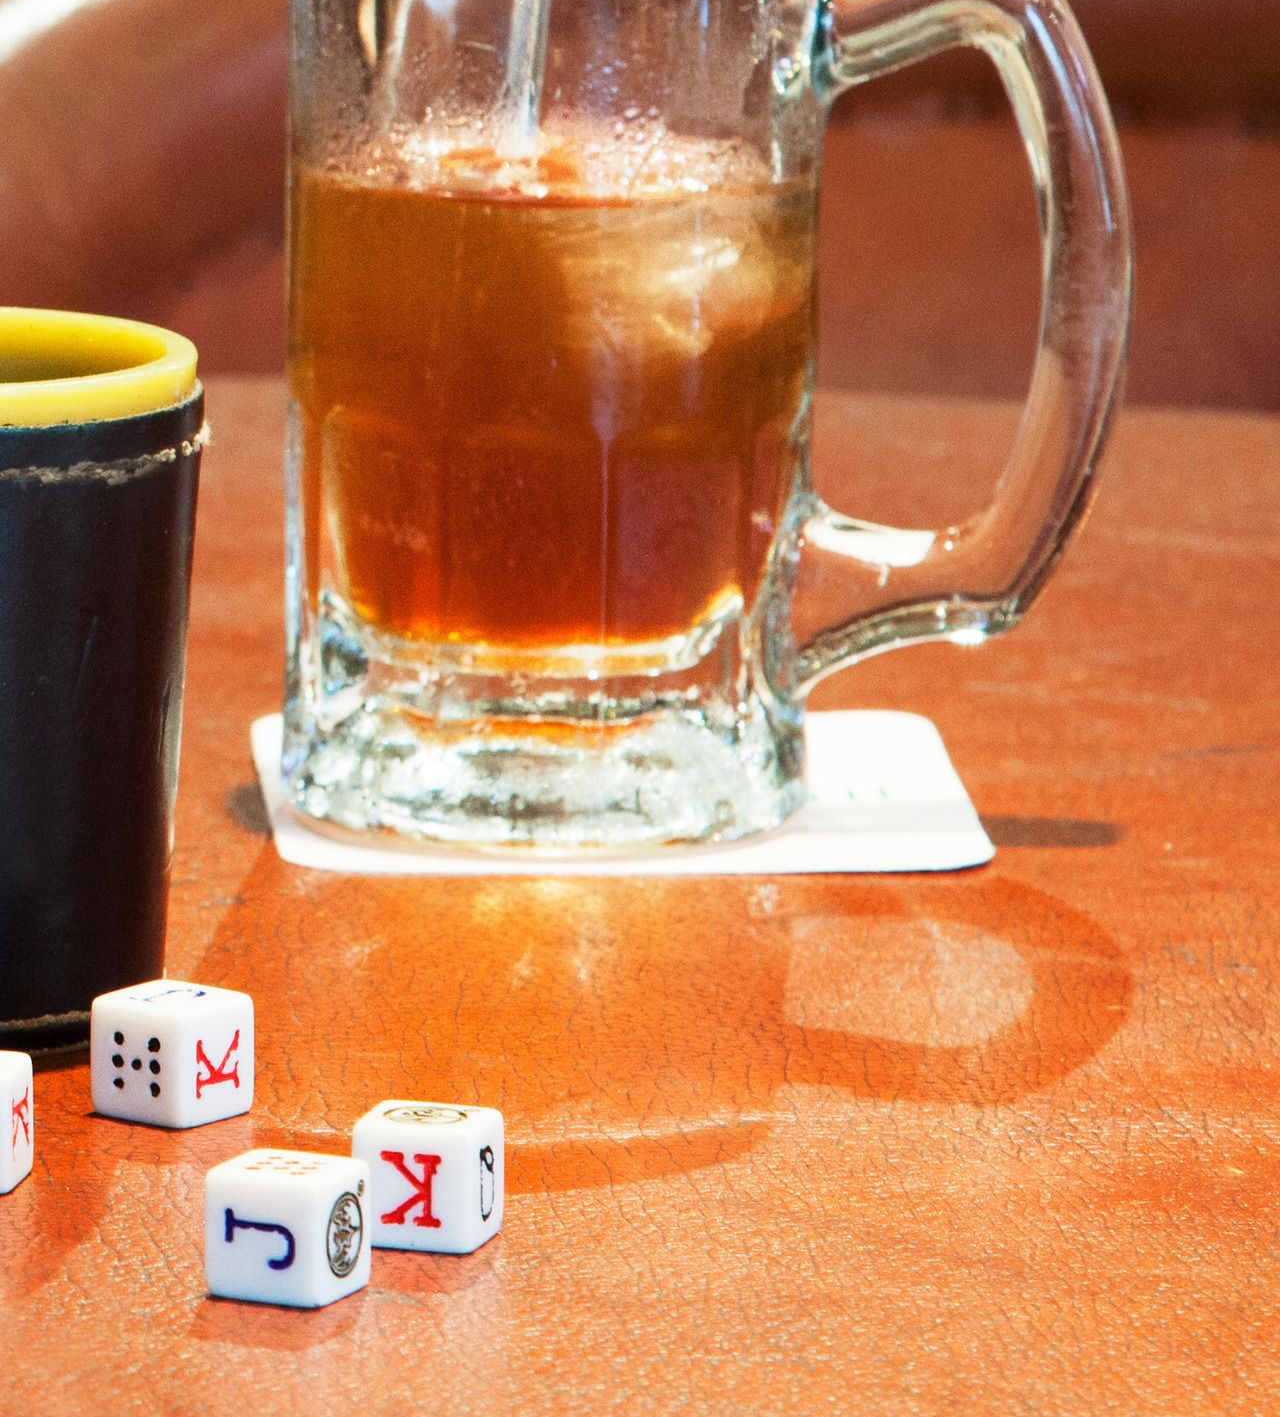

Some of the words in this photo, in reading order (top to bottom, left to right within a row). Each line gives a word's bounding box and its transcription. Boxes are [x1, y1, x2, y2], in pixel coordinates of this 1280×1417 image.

[196, 1028, 240, 1100] K
[380, 1150, 443, 1229] K
[224, 1207, 297, 1271] J
